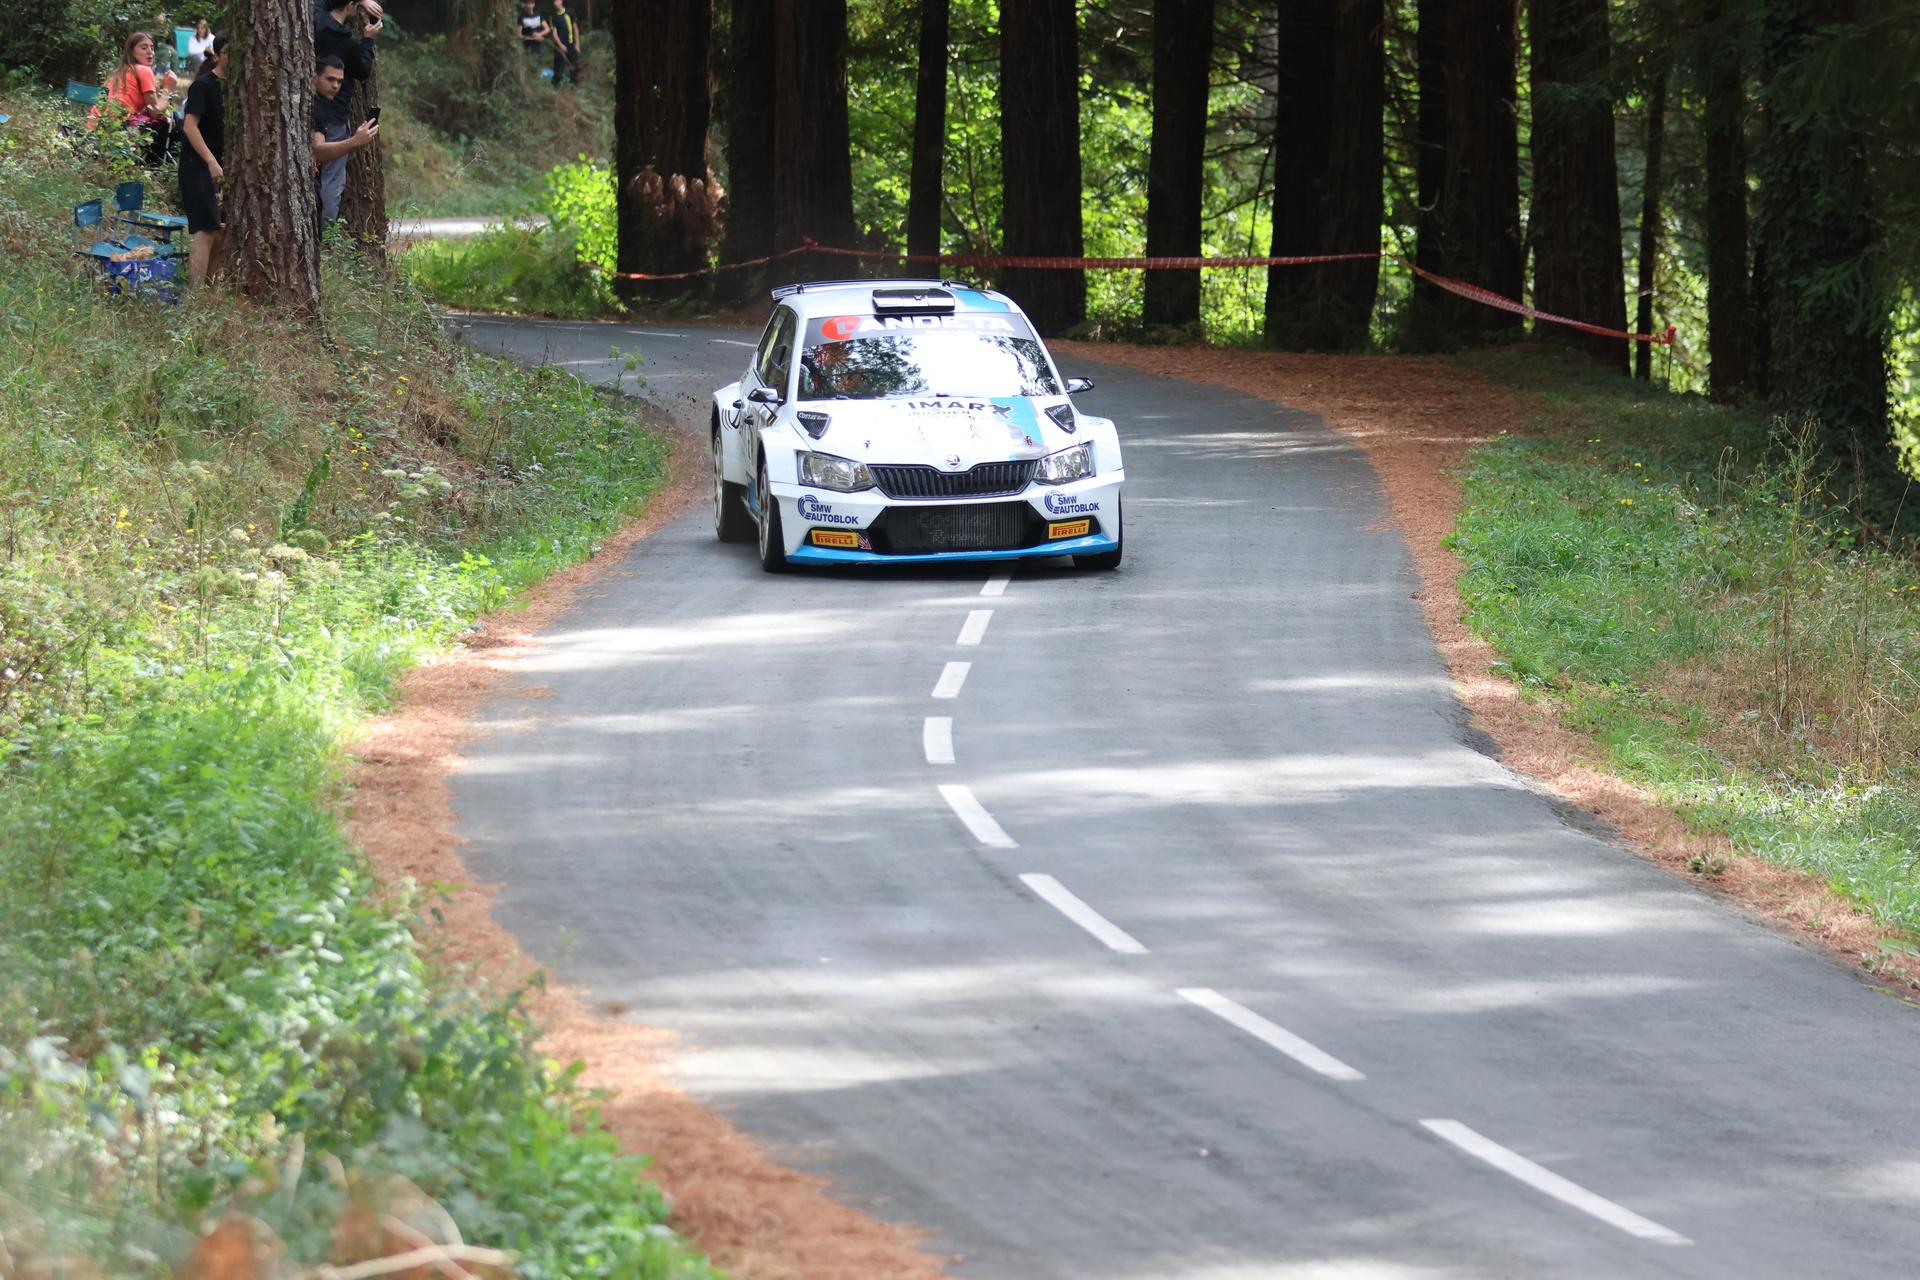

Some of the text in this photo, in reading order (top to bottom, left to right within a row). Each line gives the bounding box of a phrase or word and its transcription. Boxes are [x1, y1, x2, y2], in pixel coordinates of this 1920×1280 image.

[1058, 495, 1077, 506] SMW
[810, 503, 832, 513] SMW
[1060, 502, 1100, 514] AUTOBLOK
[811, 513, 858, 525] AUTOBLOK
[1052, 523, 1086, 536] PIRELLI
[815, 533, 853, 545] PIRELLI
